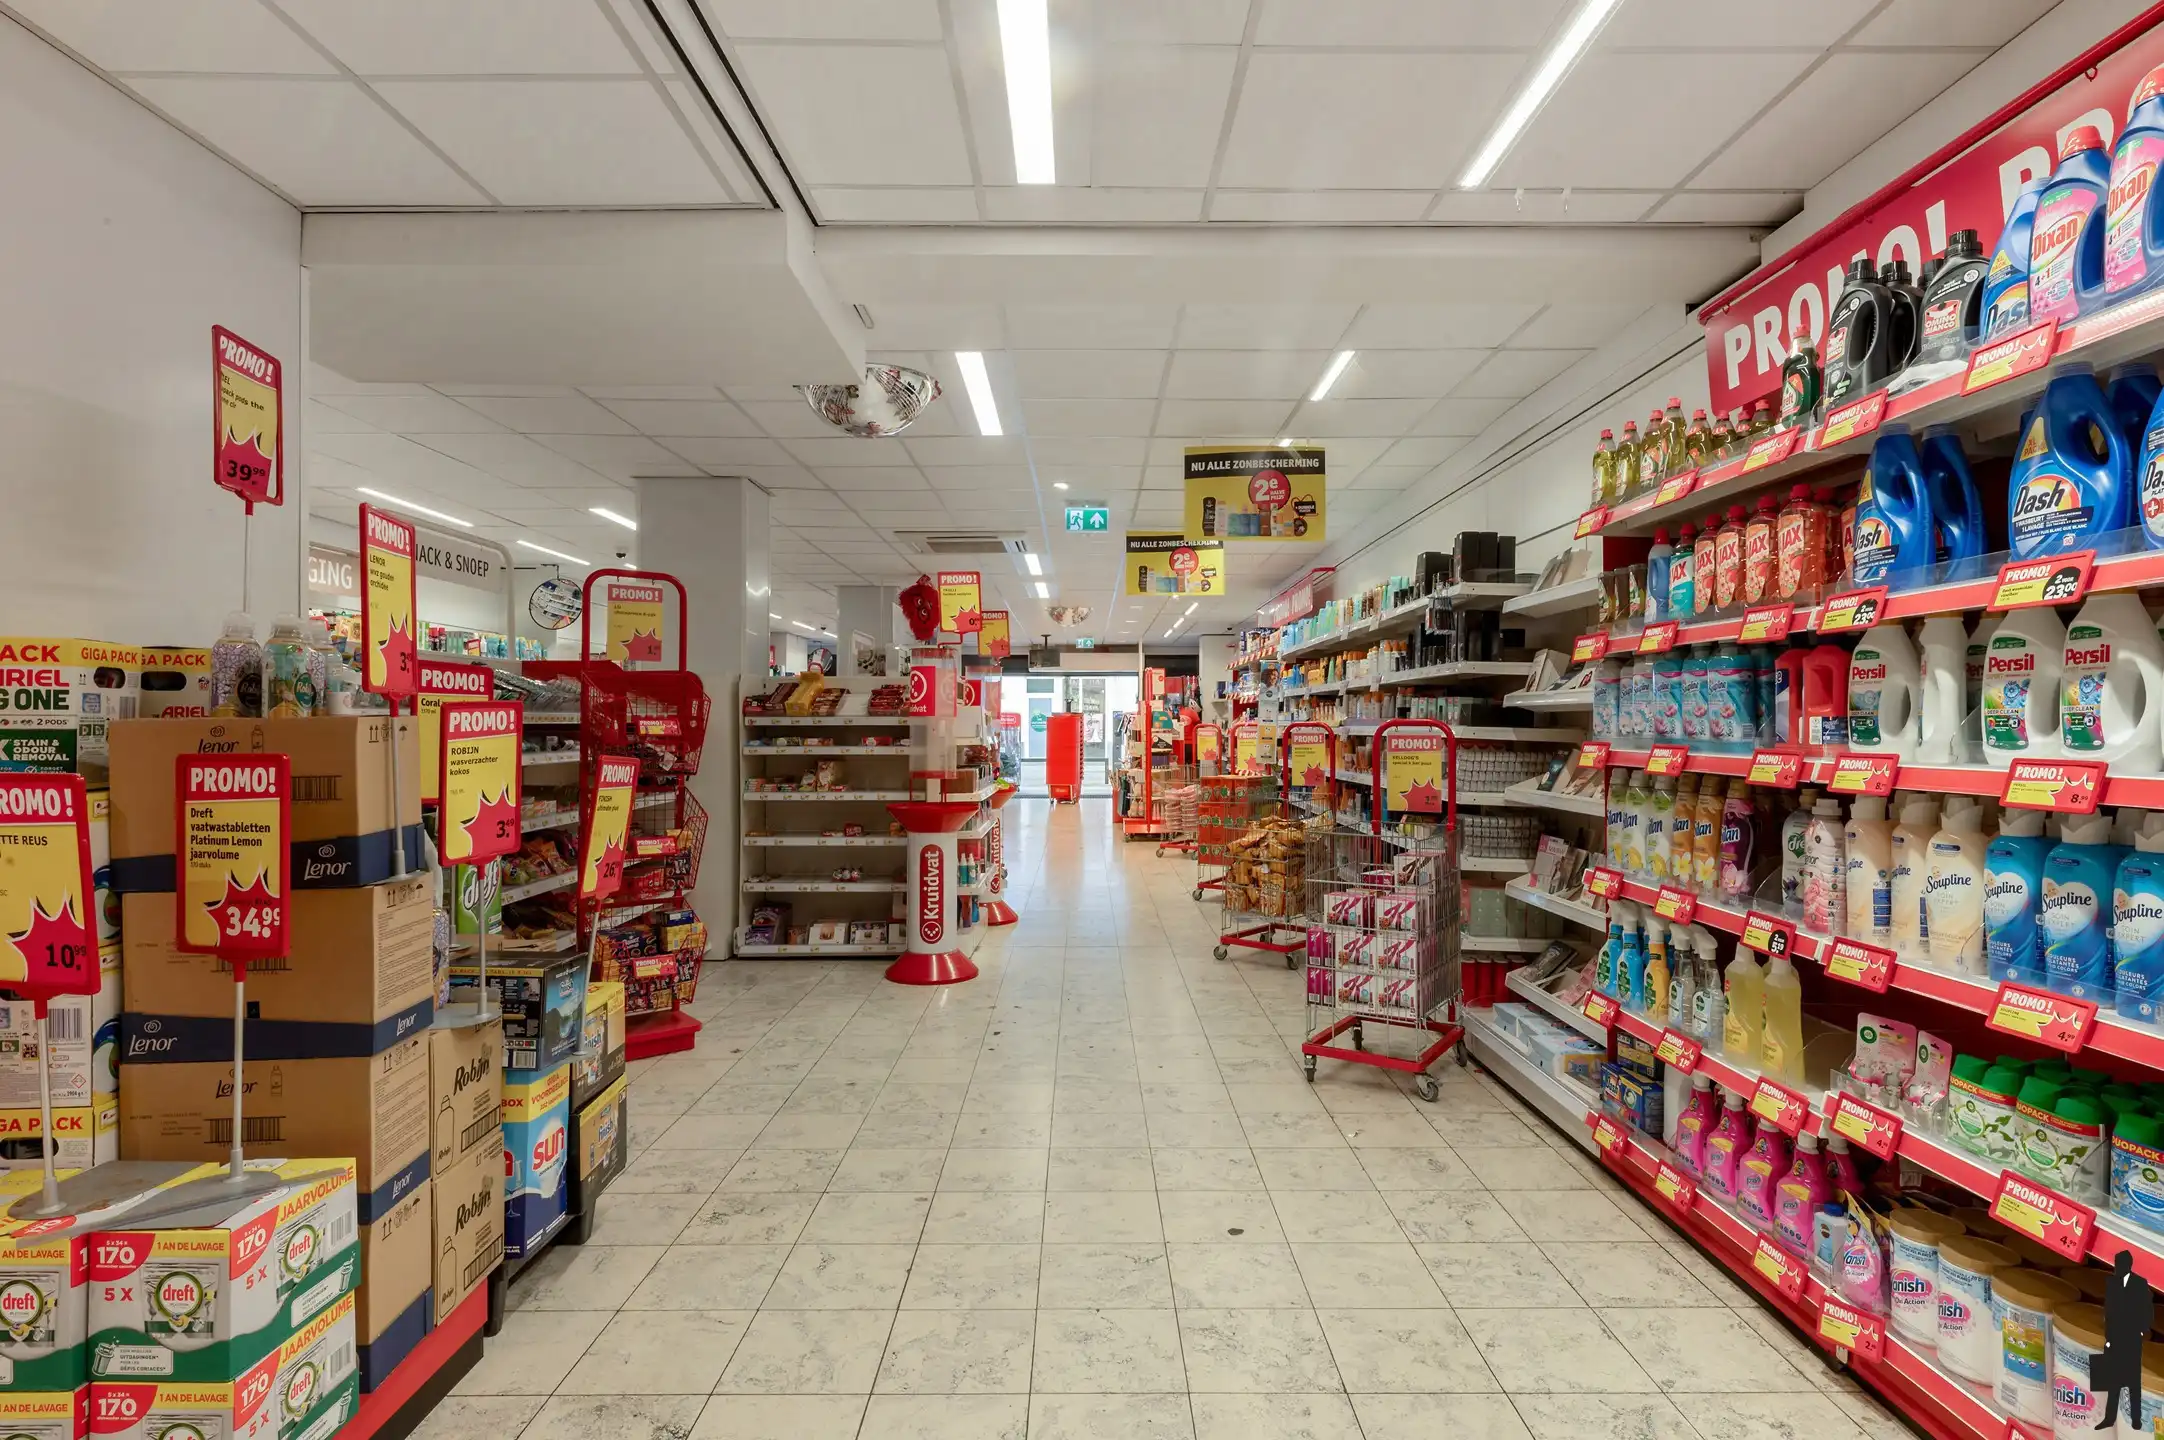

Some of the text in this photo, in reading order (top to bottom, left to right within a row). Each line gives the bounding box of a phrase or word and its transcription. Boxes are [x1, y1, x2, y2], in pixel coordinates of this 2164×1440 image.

[2109, 169, 2148, 218] Dixan
[2032, 217, 2078, 262] Dixan
[220, 335, 273, 383] PROMO!
[1976, 340, 2020, 368] PROMO!
[1829, 406, 1861, 425] PROMO!
[1191, 458, 1319, 471] NU ALLE ZONBESCHERMING
[2014, 480, 2066, 517] Dash
[368, 513, 410, 552] PROMO!
[1854, 523, 1882, 549] Dash
[369, 552, 386, 567] LENOR
[415, 543, 489, 578] ACK & SNOEP
[941, 575, 977, 584] PROMO!
[2005, 565, 2051, 582] PROMO!
[2054, 575, 2062, 583] 2
[612, 587, 660, 601] PROMO!
[2044, 582, 2077, 600] 23.00
[1829, 597, 1858, 610] PROMO!
[1860, 605, 1866, 613] 2
[1746, 611, 1772, 623] PROMO!
[81, 648, 138, 663] GIGA PACK
[163, 655, 205, 665] PACK
[1988, 653, 2034, 673] Persil
[2065, 644, 2111, 666] Persil
[421, 668, 486, 692] PROMO!
[1852, 664, 1886, 680] Persil
[15, 689, 69, 710] ONE
[421, 697, 441, 707] Coral
[162, 706, 209, 717] ARIEL
[449, 709, 515, 733] PROMO!
[1294, 734, 1324, 743] PROMO!
[1392, 739, 1437, 749] PROMO!
[451, 746, 480, 755] ROBIJN
[1653, 748, 1672, 758] PROMO!
[450, 756, 498, 766] wasverzachter
[1756, 754, 1782, 765] PROMO!
[1839, 759, 1872, 770] PROMO!
[191, 767, 275, 794] PROMO!
[601, 764, 635, 784] PROMO!
[2015, 766, 2064, 781] PROMO!
[2070, 793, 2089, 804] 8.99
[191, 808, 213, 818] Dreft
[191, 822, 270, 833] vaatwastabletten
[22, 836, 47, 845] REUS
[191, 835, 262, 847] Platinum Lemon
[190, 848, 239, 860] jaarvolume
[304, 858, 351, 881] Lenor
[924, 850, 940, 920] Kruidvat
[1926, 874, 1972, 894] Soupline
[1984, 882, 2023, 902] Soupline
[1660, 889, 1681, 902] PROMO!
[2043, 892, 2092, 913] Soupline
[1748, 916, 1772, 930] PROMO!
[2113, 903, 2163, 926] Soupline
[1835, 943, 1868, 960] PROMO!
[2003, 991, 2053, 1013] PROMO!
[396, 1012, 417, 1037] Lenor
[128, 1035, 178, 1056] Lenor
[1664, 1032, 1684, 1048] PROMO!
[2057, 1032, 2075, 1042] 4.99
[454, 1058, 490, 1096] Robijn
[1759, 1082, 1787, 1102] PROMO!
[1840, 1098, 1874, 1121] PROMO!
[1660, 1164, 1680, 1183] PROMO!
[280, 1165, 354, 1222] JAARVOLUME
[392, 1171, 413, 1199] Lenor
[2005, 1179, 2054, 1212] PROMO!
[455, 1190, 491, 1235] Robijn
[163, 1242, 176, 1250] AN
[237, 1228, 267, 1259] 170
[289, 1234, 311, 1259] dreft
[2059, 1235, 2077, 1248] 4.99
[31, 1250, 65, 1259] LAVAGE
[97, 1247, 136, 1264] 170
[1758, 1239, 1787, 1266] PROMO!
[1844, 1248, 1866, 1266] Vanish
[246, 1276, 254, 1290] 5
[104, 1288, 134, 1302] 5 X
[163, 1284, 195, 1301] dreft
[3, 1293, 35, 1310] dreft
[1823, 1301, 1858, 1325] PROMO!
[282, 1294, 352, 1364] JAARVOLUME
[1943, 1322, 1963, 1331] Action
[241, 1374, 269, 1408] 170
[290, 1374, 311, 1402] dreft
[166, 1394, 178, 1402] AN
[180, 1394, 192, 1402] DE
[194, 1394, 228, 1402] LAVAGE
[33, 1404, 68, 1412] LAVAGE
[98, 1399, 137, 1416] 170
[2062, 1409, 2086, 1420] Action
[249, 1418, 258, 1438] 5
